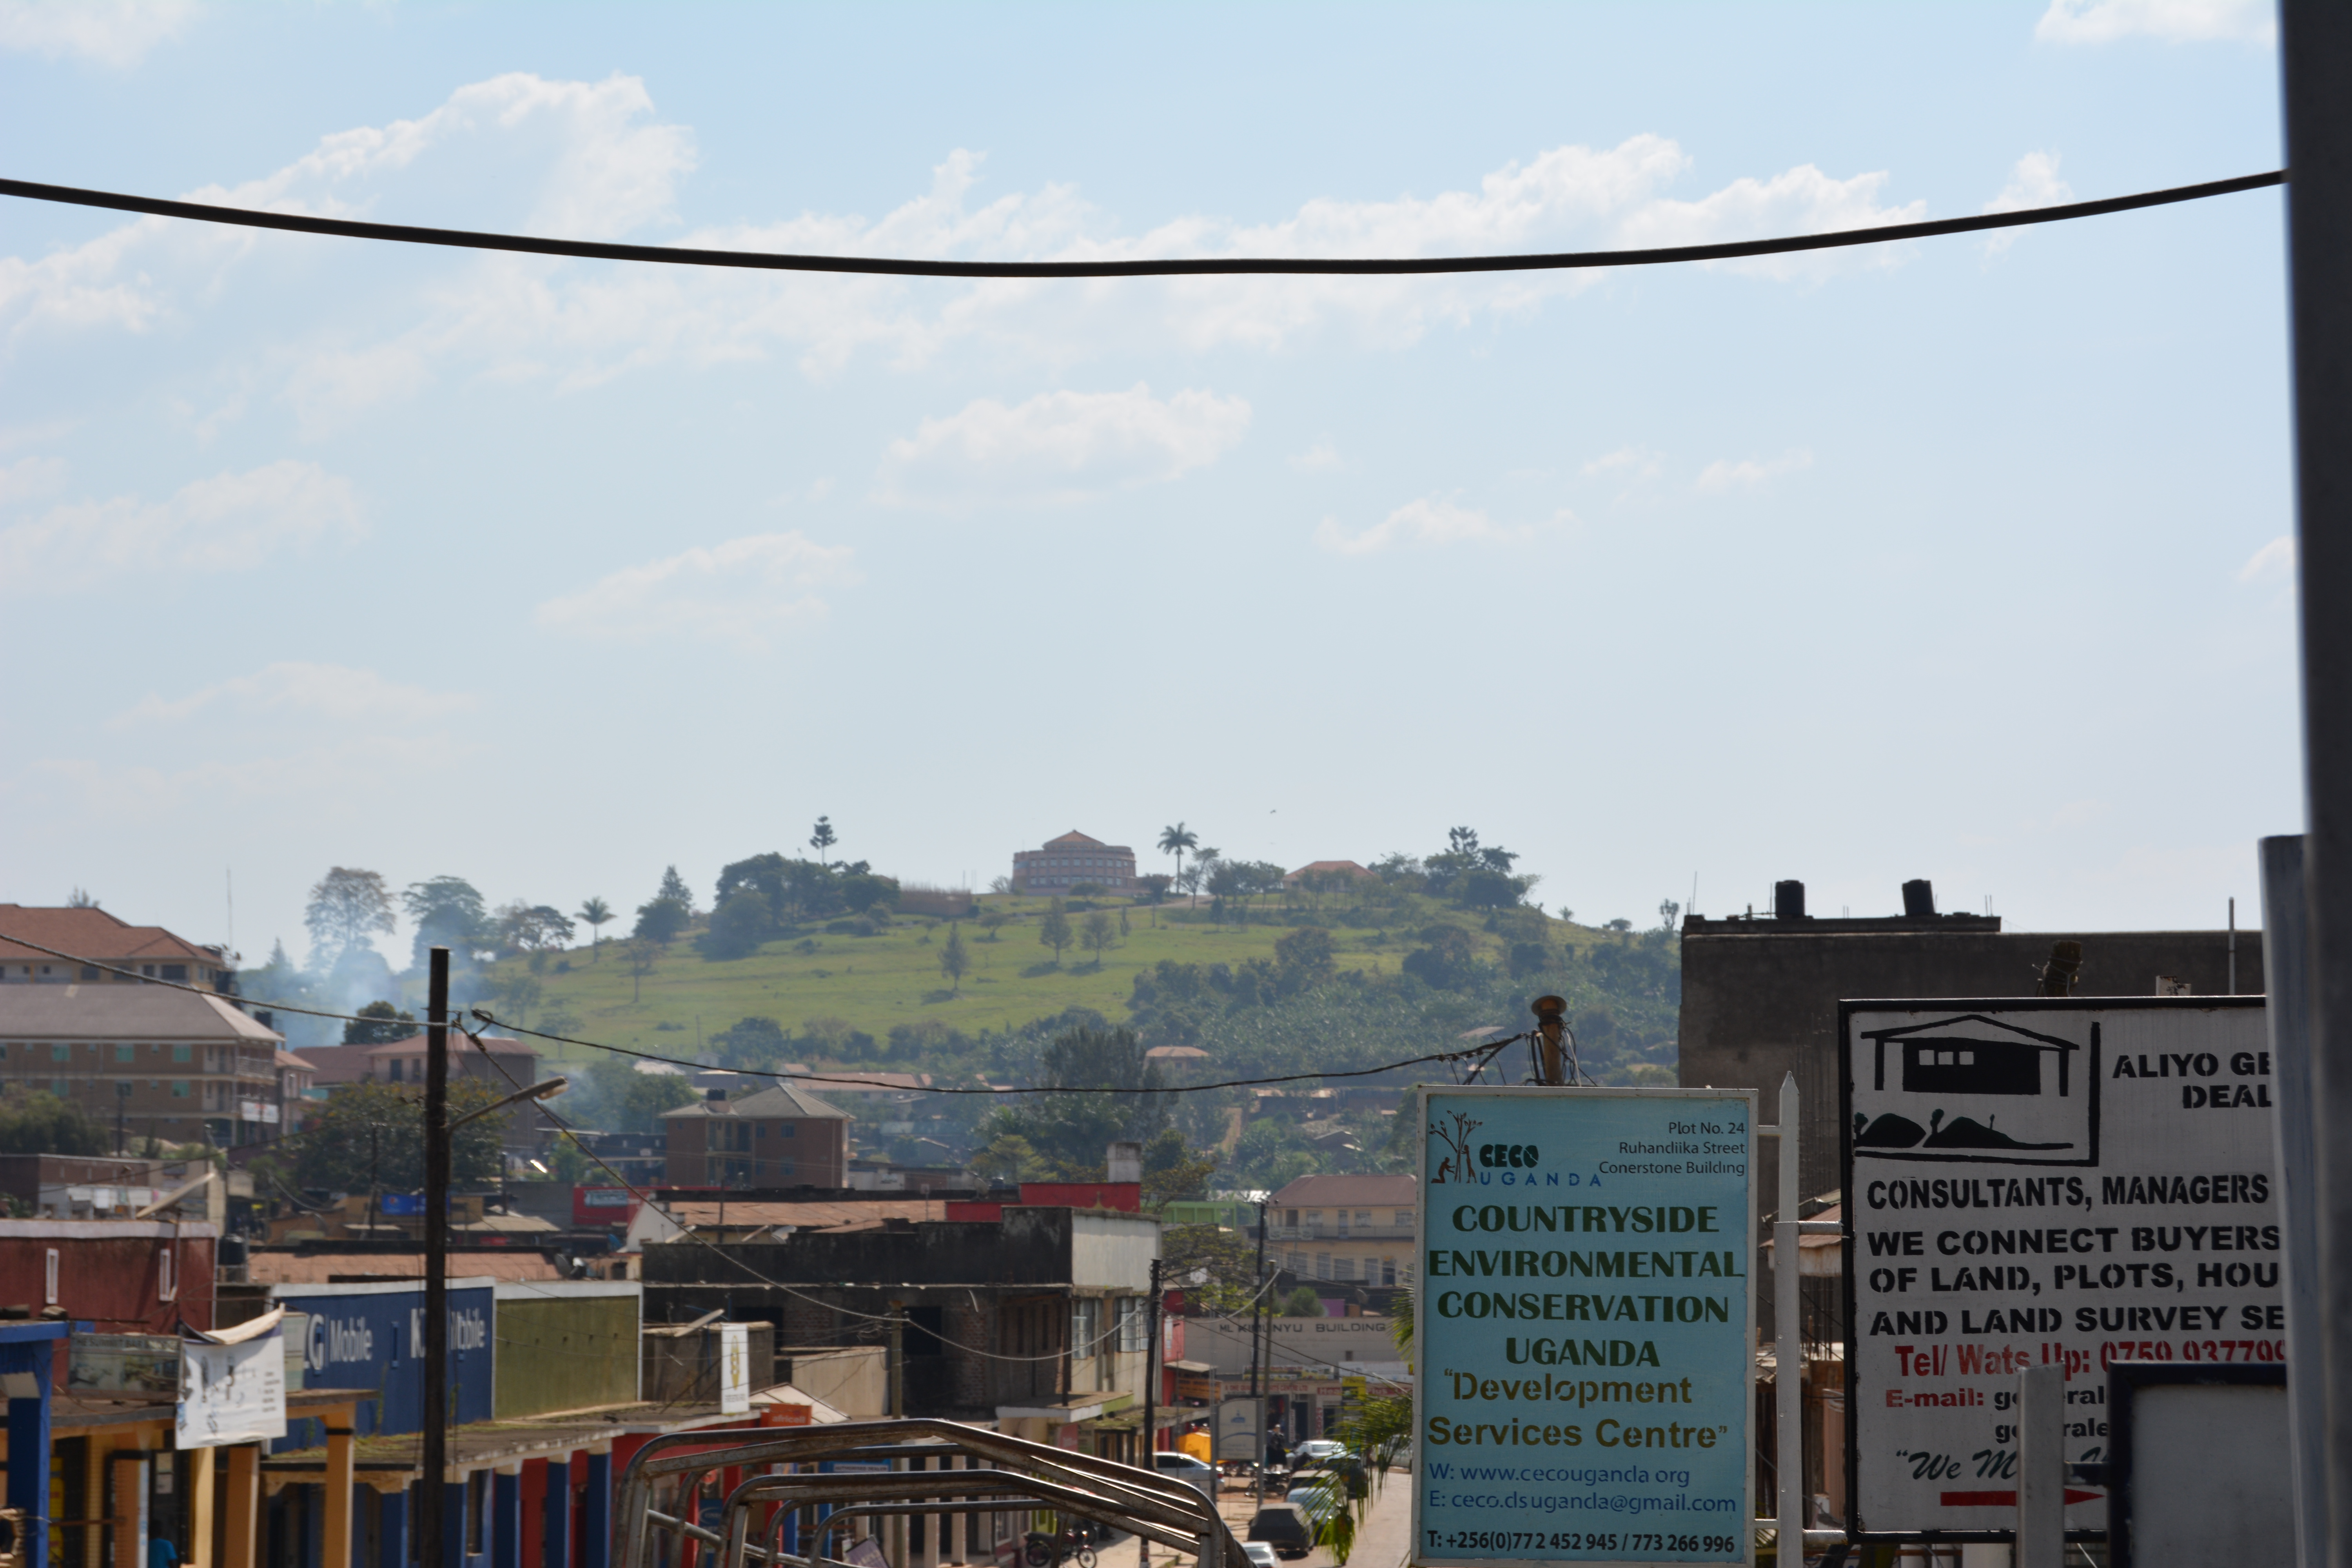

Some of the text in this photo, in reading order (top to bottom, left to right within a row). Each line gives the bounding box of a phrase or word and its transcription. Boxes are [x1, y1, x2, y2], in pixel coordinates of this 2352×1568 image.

[2113, 1053, 2219, 1079] ALIYO
[1669, 1122, 1745, 1135] Plot No. 24
[1480, 1144, 1539, 1169] CECO
[1704, 1142, 1746, 1154] Street
[1481, 1172, 1602, 1187] UGANDA
[1599, 1161, 1745, 1177] Conerstone Building
[1867, 1174, 2269, 1212] CONSULTANTS, MANAGERS
[1453, 1205, 1720, 1233] COUNTRYSIDE
[1867, 1226, 2280, 1257] WE CONNECT BUYERS
[1429, 1250, 1746, 1278] ENVIRONMENTAL
[1870, 1268, 1918, 1293] OF
[1931, 1267, 2041, 1297] LAND,
[2054, 1263, 2184, 1293] PLOTS,
[1438, 1291, 1728, 1323] CONSERVATION
[1316, 1323, 1386, 1332] BUILDING
[1870, 1311, 1948, 1336] AND
[1962, 1308, 2062, 1334] LAND
[2076, 1306, 2228, 1332] SURVEY
[330, 1316, 373, 1362] Mobile
[1506, 1338, 1661, 1367] UGANDA
[1895, 1345, 1948, 1377] Tel/
[1957, 1345, 2031, 1375] Wats
[1886, 1388, 1984, 1408] E-mail:
[772, 1415, 806, 1424] africell
[1428, 1417, 1583, 1446] Services
[1429, 1463, 1454, 1480] W:
[1430, 1490, 1446, 1507] E:
[1427, 1530, 1442, 1548] T:
[1550, 1534, 1582, 1550] 452
[1586, 1534, 1617, 1551] 945
[1622, 1534, 1629, 1552] /
[1633, 1534, 1663, 1551] 773
[1668, 1534, 1699, 1552] 266
[1703, 1536, 1735, 1553] 996
